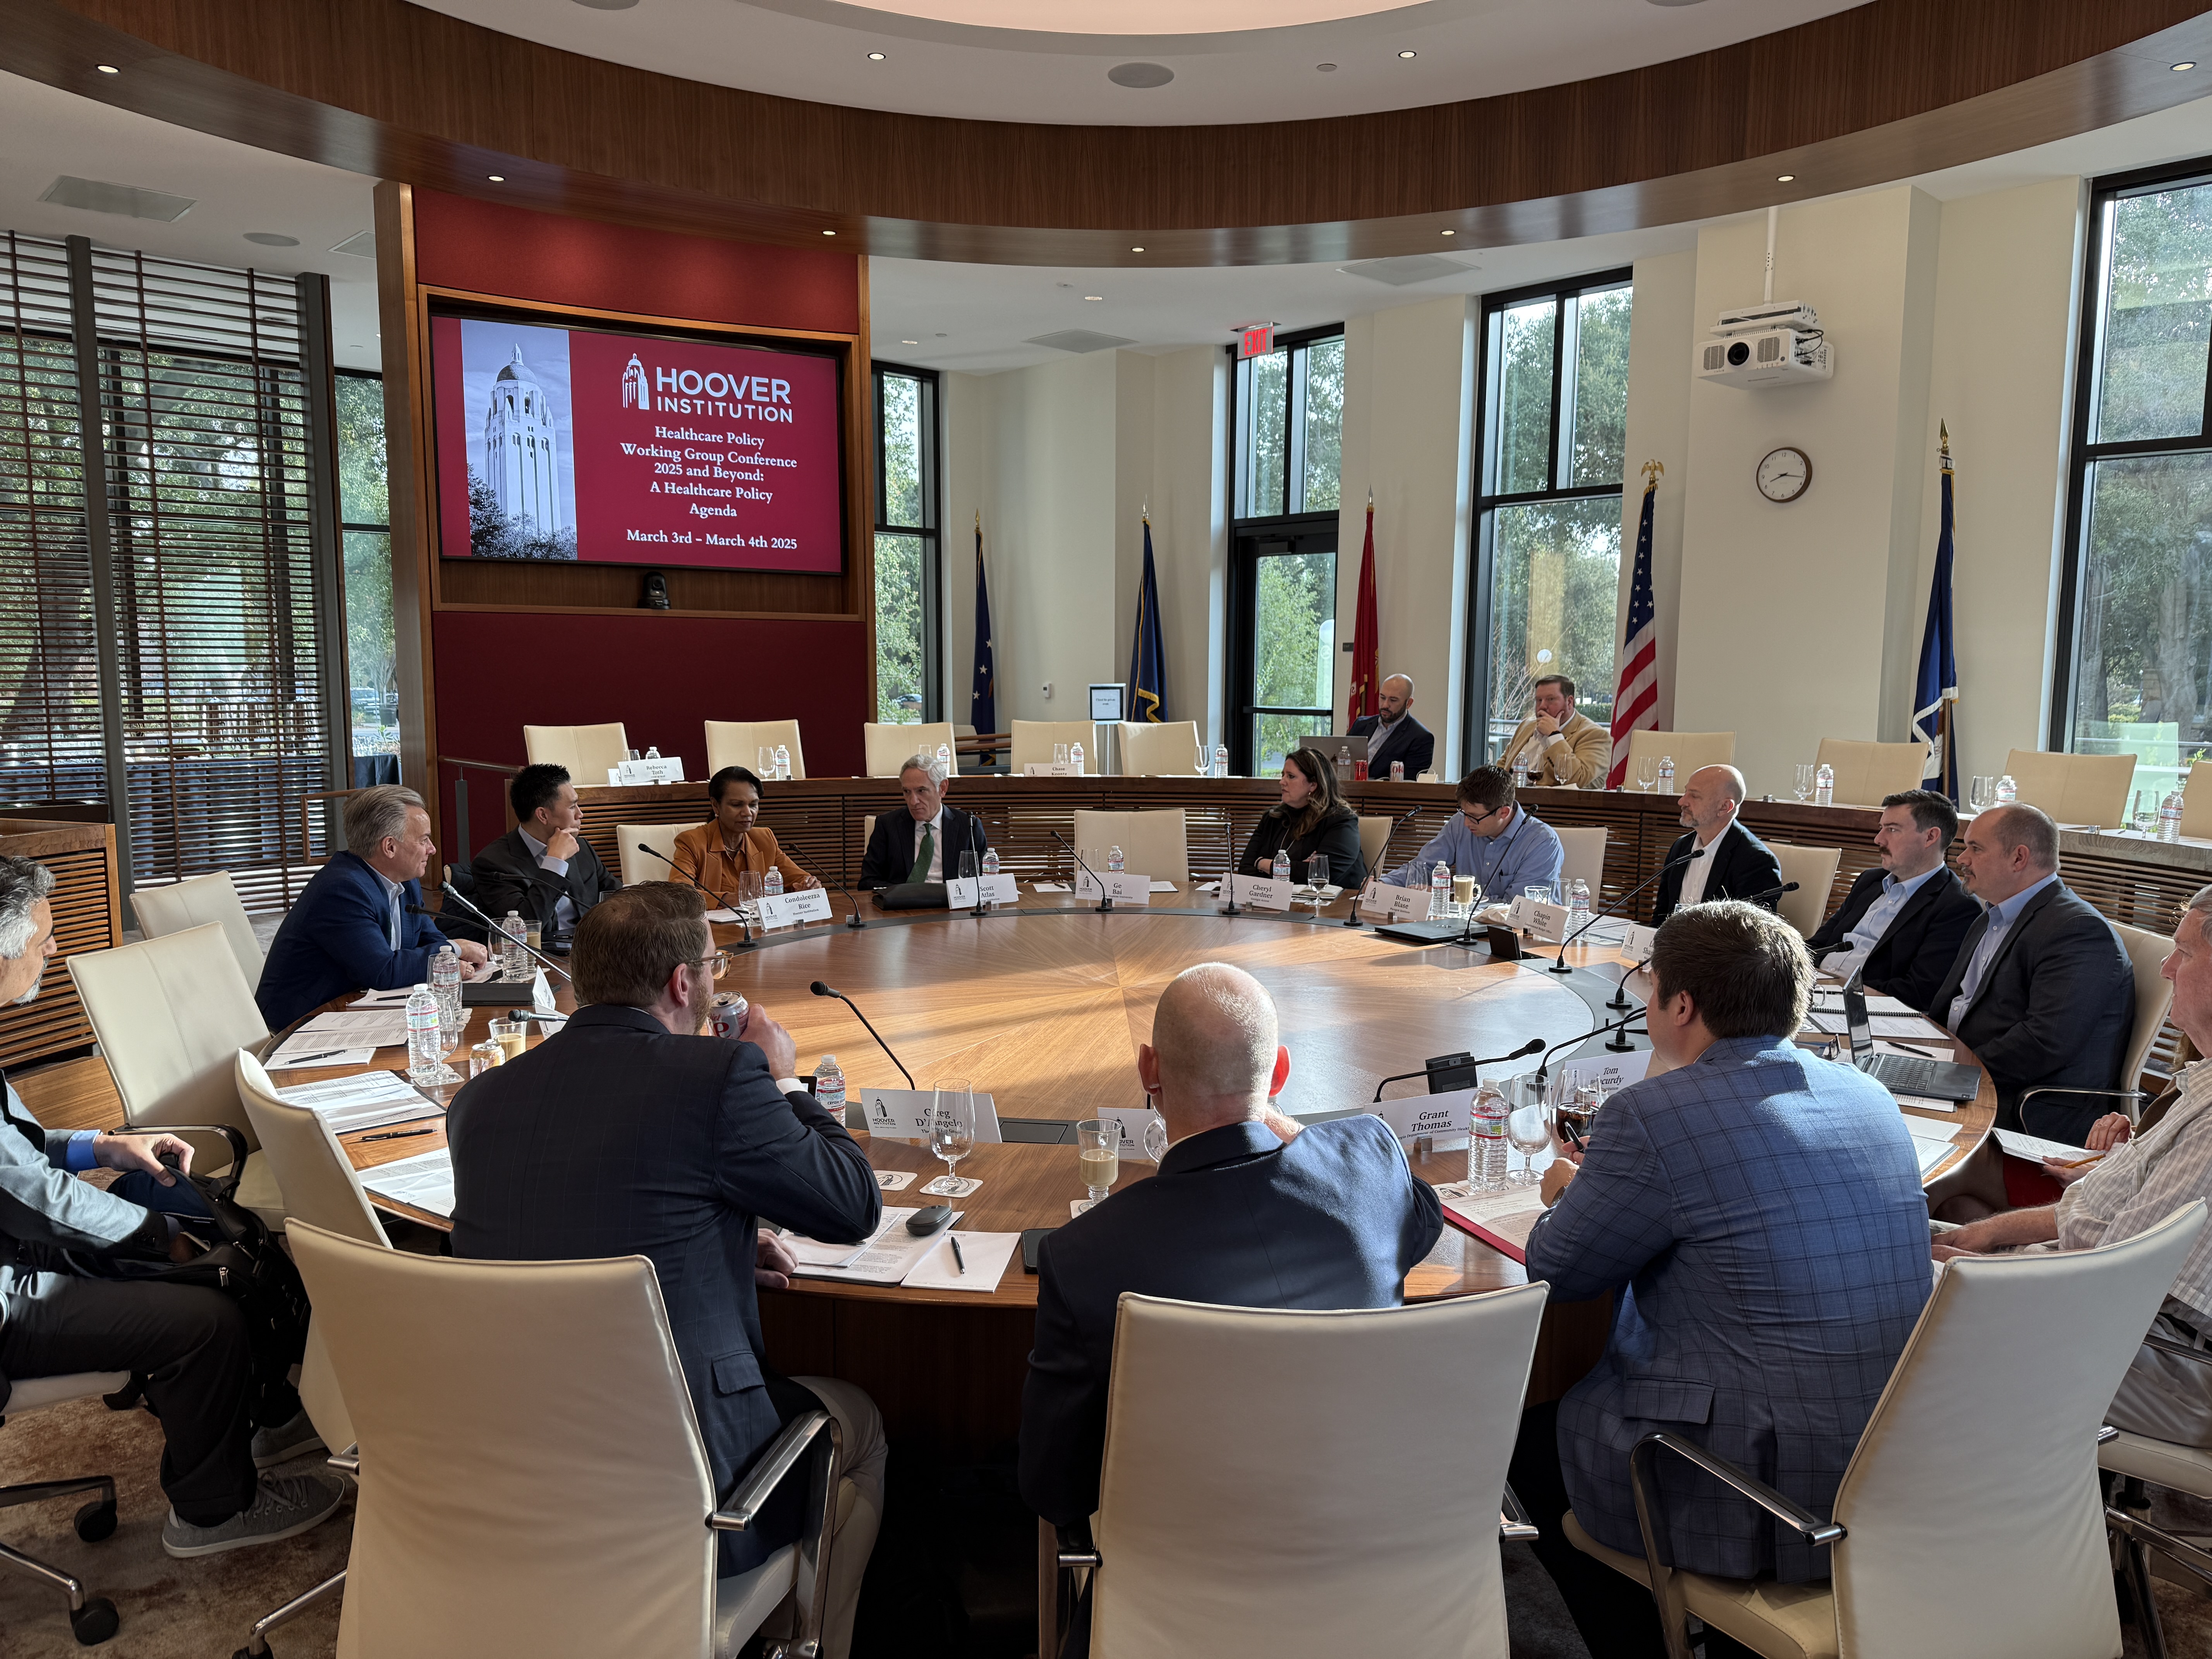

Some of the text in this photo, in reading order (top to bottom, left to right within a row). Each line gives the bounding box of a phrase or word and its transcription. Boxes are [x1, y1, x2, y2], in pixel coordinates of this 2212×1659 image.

[1245, 328, 1267, 356] EXIT
[656, 367, 791, 404] HOOVER
[657, 396, 793, 423] INSTITUTION
[655, 426, 764, 450] Healthcare Policy
[620, 443, 797, 467] Working Group Conference
[654, 462, 764, 483] 2025 and Beyond:
[650, 481, 773, 504] A Healthcare Policy
[689, 503, 737, 519] Agenda
[627, 529, 668, 543] March
[672, 531, 692, 544] 3rd
[706, 533, 745, 547] March
[748, 536, 768, 548] 4th
[771, 538, 797, 550] 2025
[785, 893, 820, 903] Condoleezza
[1533, 917, 1547, 927] White
[1534, 910, 1551, 921] Chapin
[1419, 1109, 1449, 1120] Grant
[1411, 1120, 1452, 1132] Thomas
